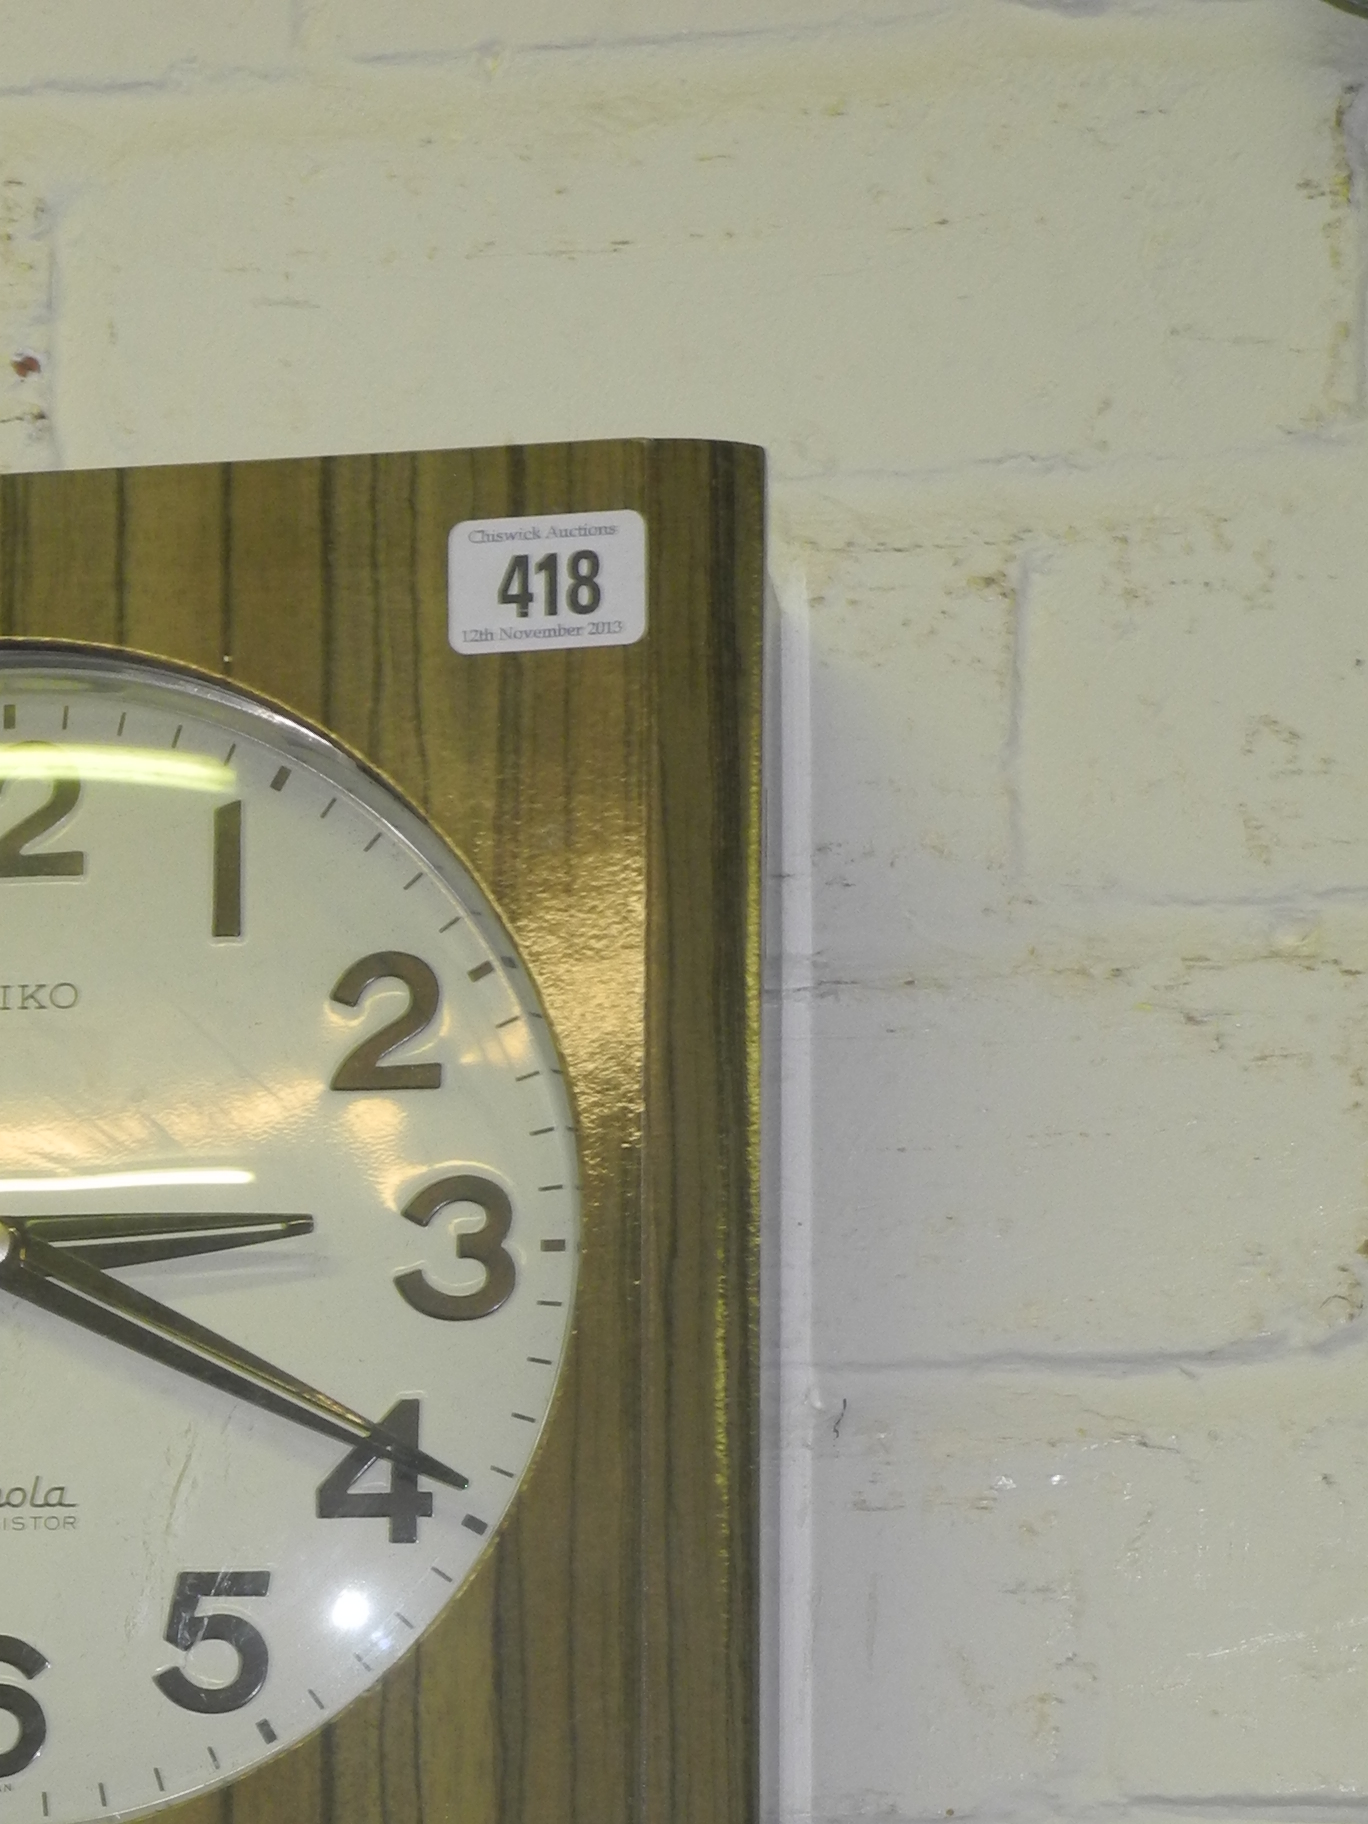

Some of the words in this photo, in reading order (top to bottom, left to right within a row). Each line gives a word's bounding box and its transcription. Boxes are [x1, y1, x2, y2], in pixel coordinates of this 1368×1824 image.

[468, 526, 541, 544] Chiswick
[546, 524, 619, 539] Auctions
[497, 549, 602, 618] 418
[462, 627, 494, 643] 12th
[500, 623, 583, 641] November
[588, 620, 623, 636] 2013
[211, 800, 242, 938] 1
[329, 951, 441, 1091] 2
[392, 1174, 516, 1321] 3
[316, 1398, 433, 1543] 4
[152, 1570, 271, 1714] 5
